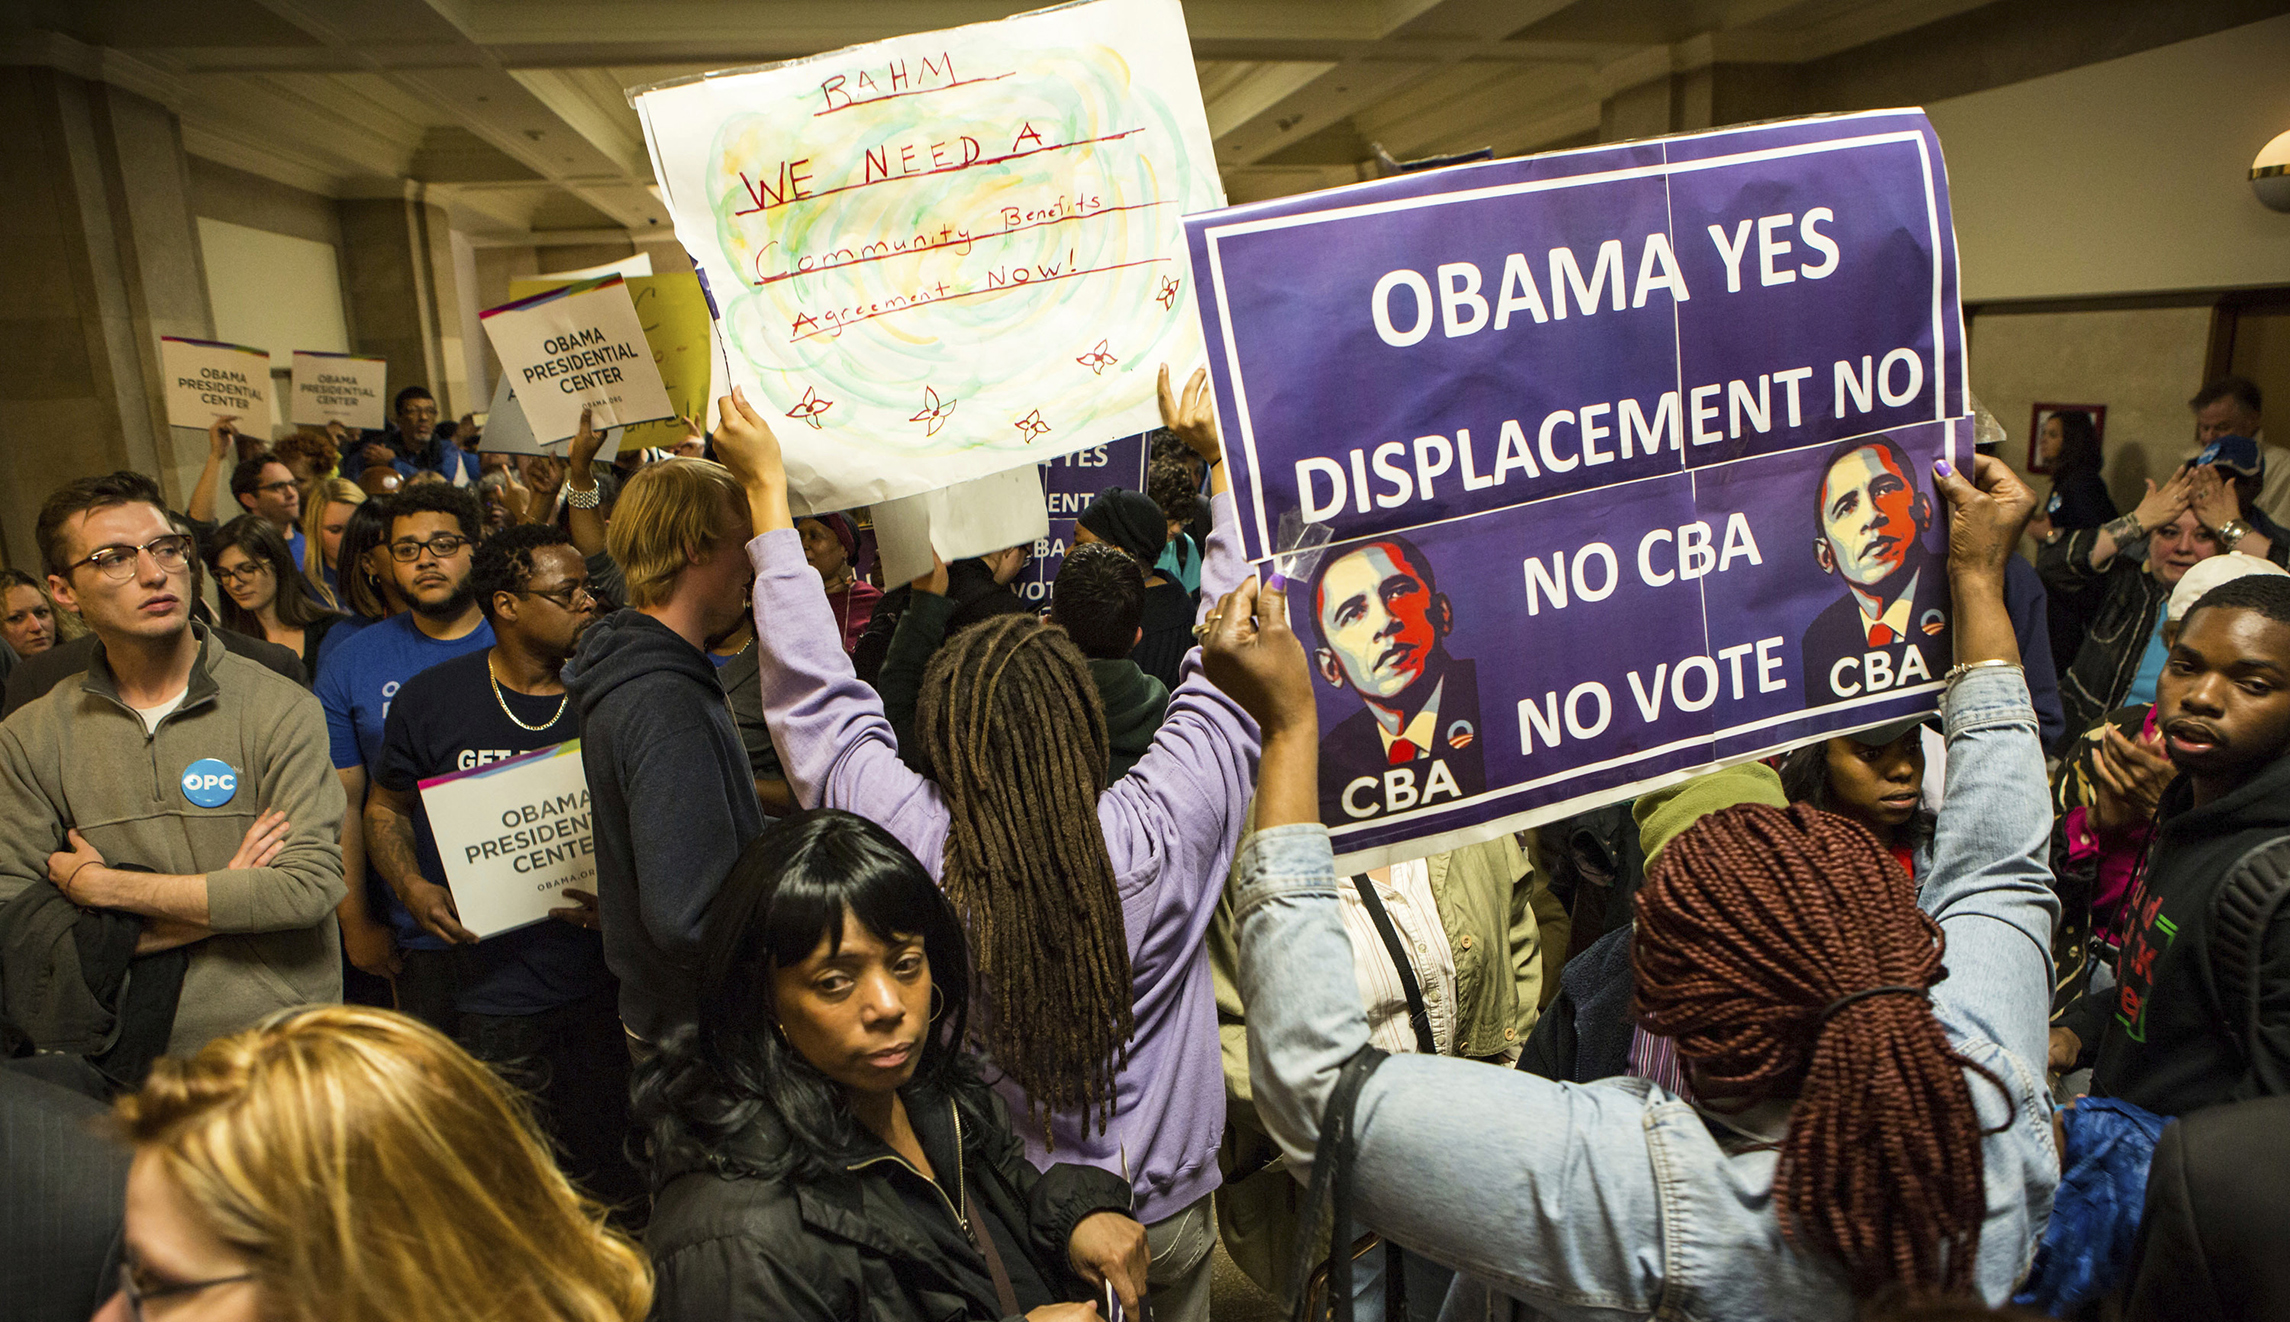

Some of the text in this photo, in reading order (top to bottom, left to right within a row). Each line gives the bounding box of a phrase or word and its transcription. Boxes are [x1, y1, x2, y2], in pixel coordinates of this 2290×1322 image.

[820, 51, 957, 110] RAHM
[739, 122, 1042, 209] WE NEED A
[756, 192, 1101, 282] Community Benefits
[791, 247, 1077, 338] Agreement NOW!
[1371, 206, 1840, 348] OBAMA YES
[543, 327, 606, 355] OBAMA
[200, 367, 247, 384] OBAMA
[318, 374, 358, 386] OBAMA
[522, 342, 639, 384] PRESIDENTIAL
[559, 366, 624, 394] CENTER
[178, 377, 263, 402] PRESIDENTIAL
[201, 393, 249, 410] CENTER
[301, 383, 376, 398] PRESIDENTIAL
[316, 395, 359, 407] CENTER
[1295, 347, 1924, 524] DISPLACEMENT NO
[1523, 512, 1763, 617] NO CBA
[1829, 645, 1932, 699] CBA
[1517, 636, 1787, 756] NO VOTE
[183, 773, 235, 791] OPC
[1341, 767, 1463, 819] CBA
[501, 789, 591, 829] OBAMA
[512, 836, 595, 874] CENTE
[537, 868, 596, 892] OBAMA.OR
